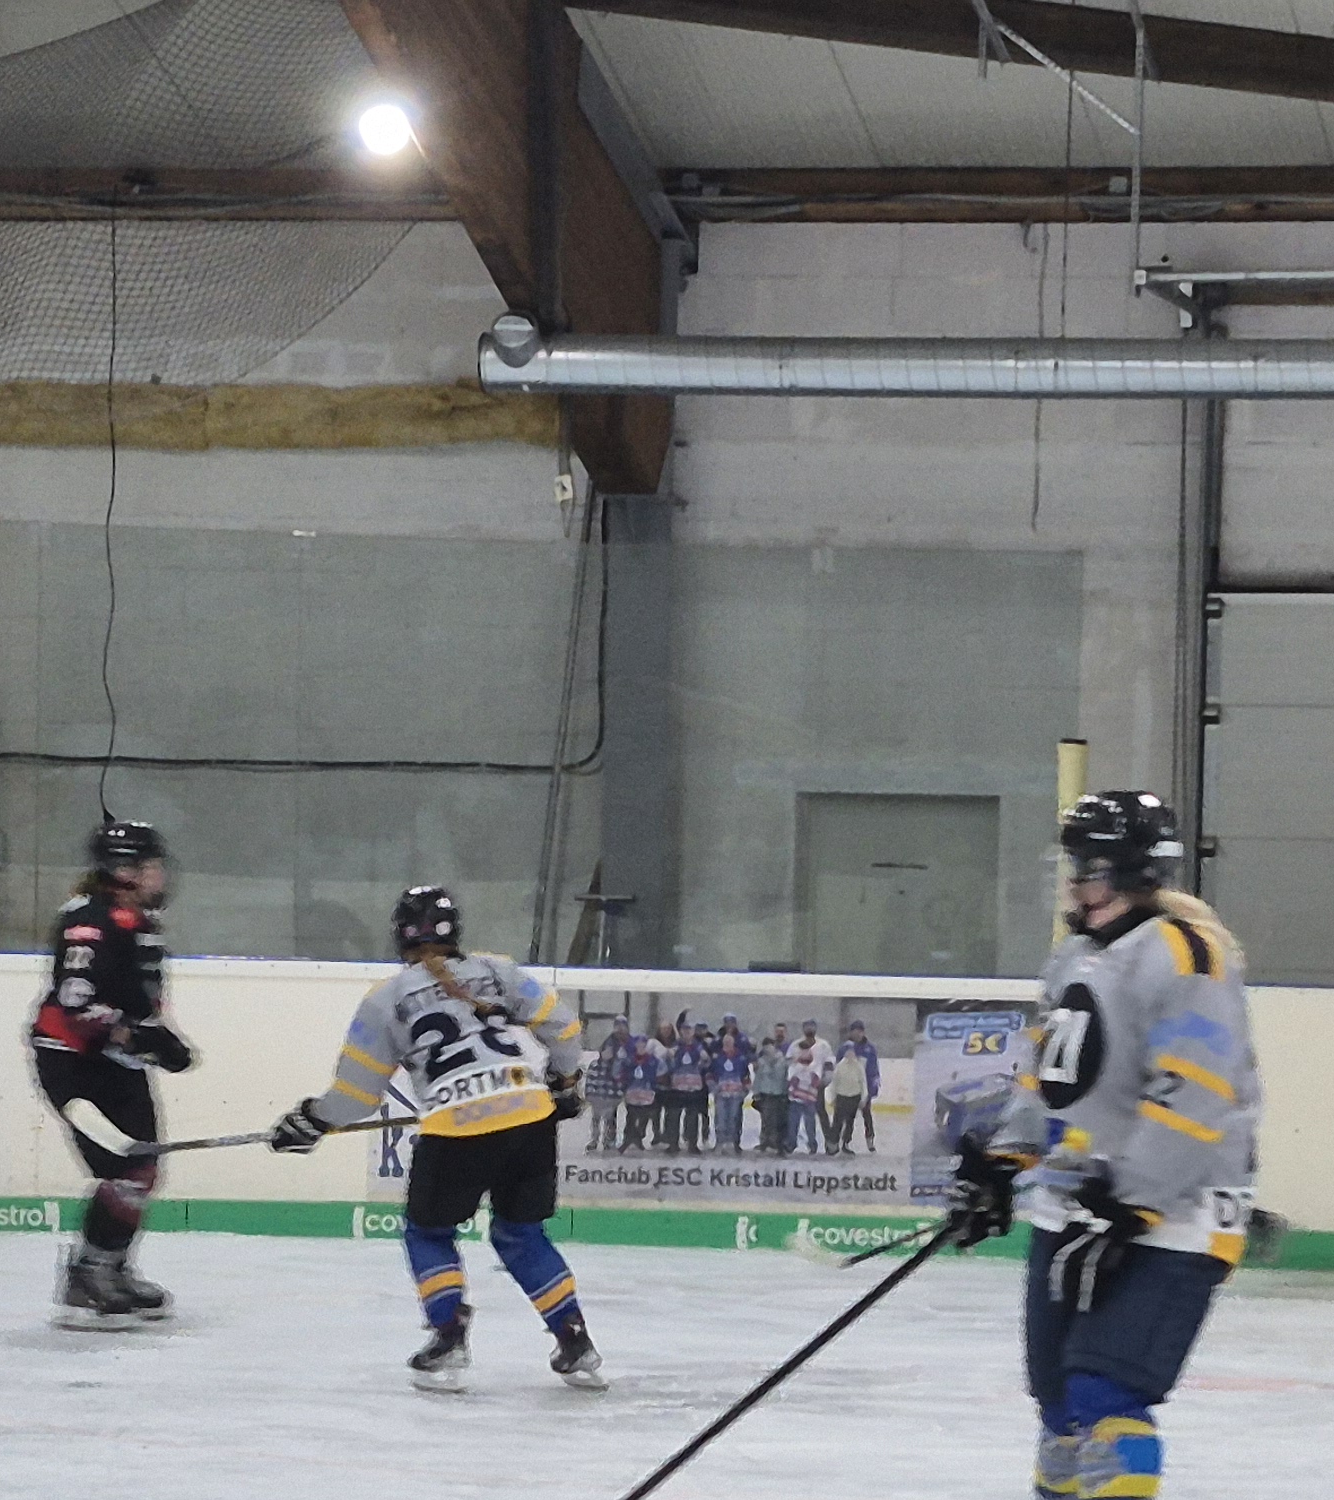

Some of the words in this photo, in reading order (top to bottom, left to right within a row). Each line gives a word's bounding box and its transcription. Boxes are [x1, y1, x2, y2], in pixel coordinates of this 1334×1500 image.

[658, 1166, 703, 1187] ESC
[710, 1168, 787, 1188] Kristall
[793, 1171, 898, 1195] Lippstadt
